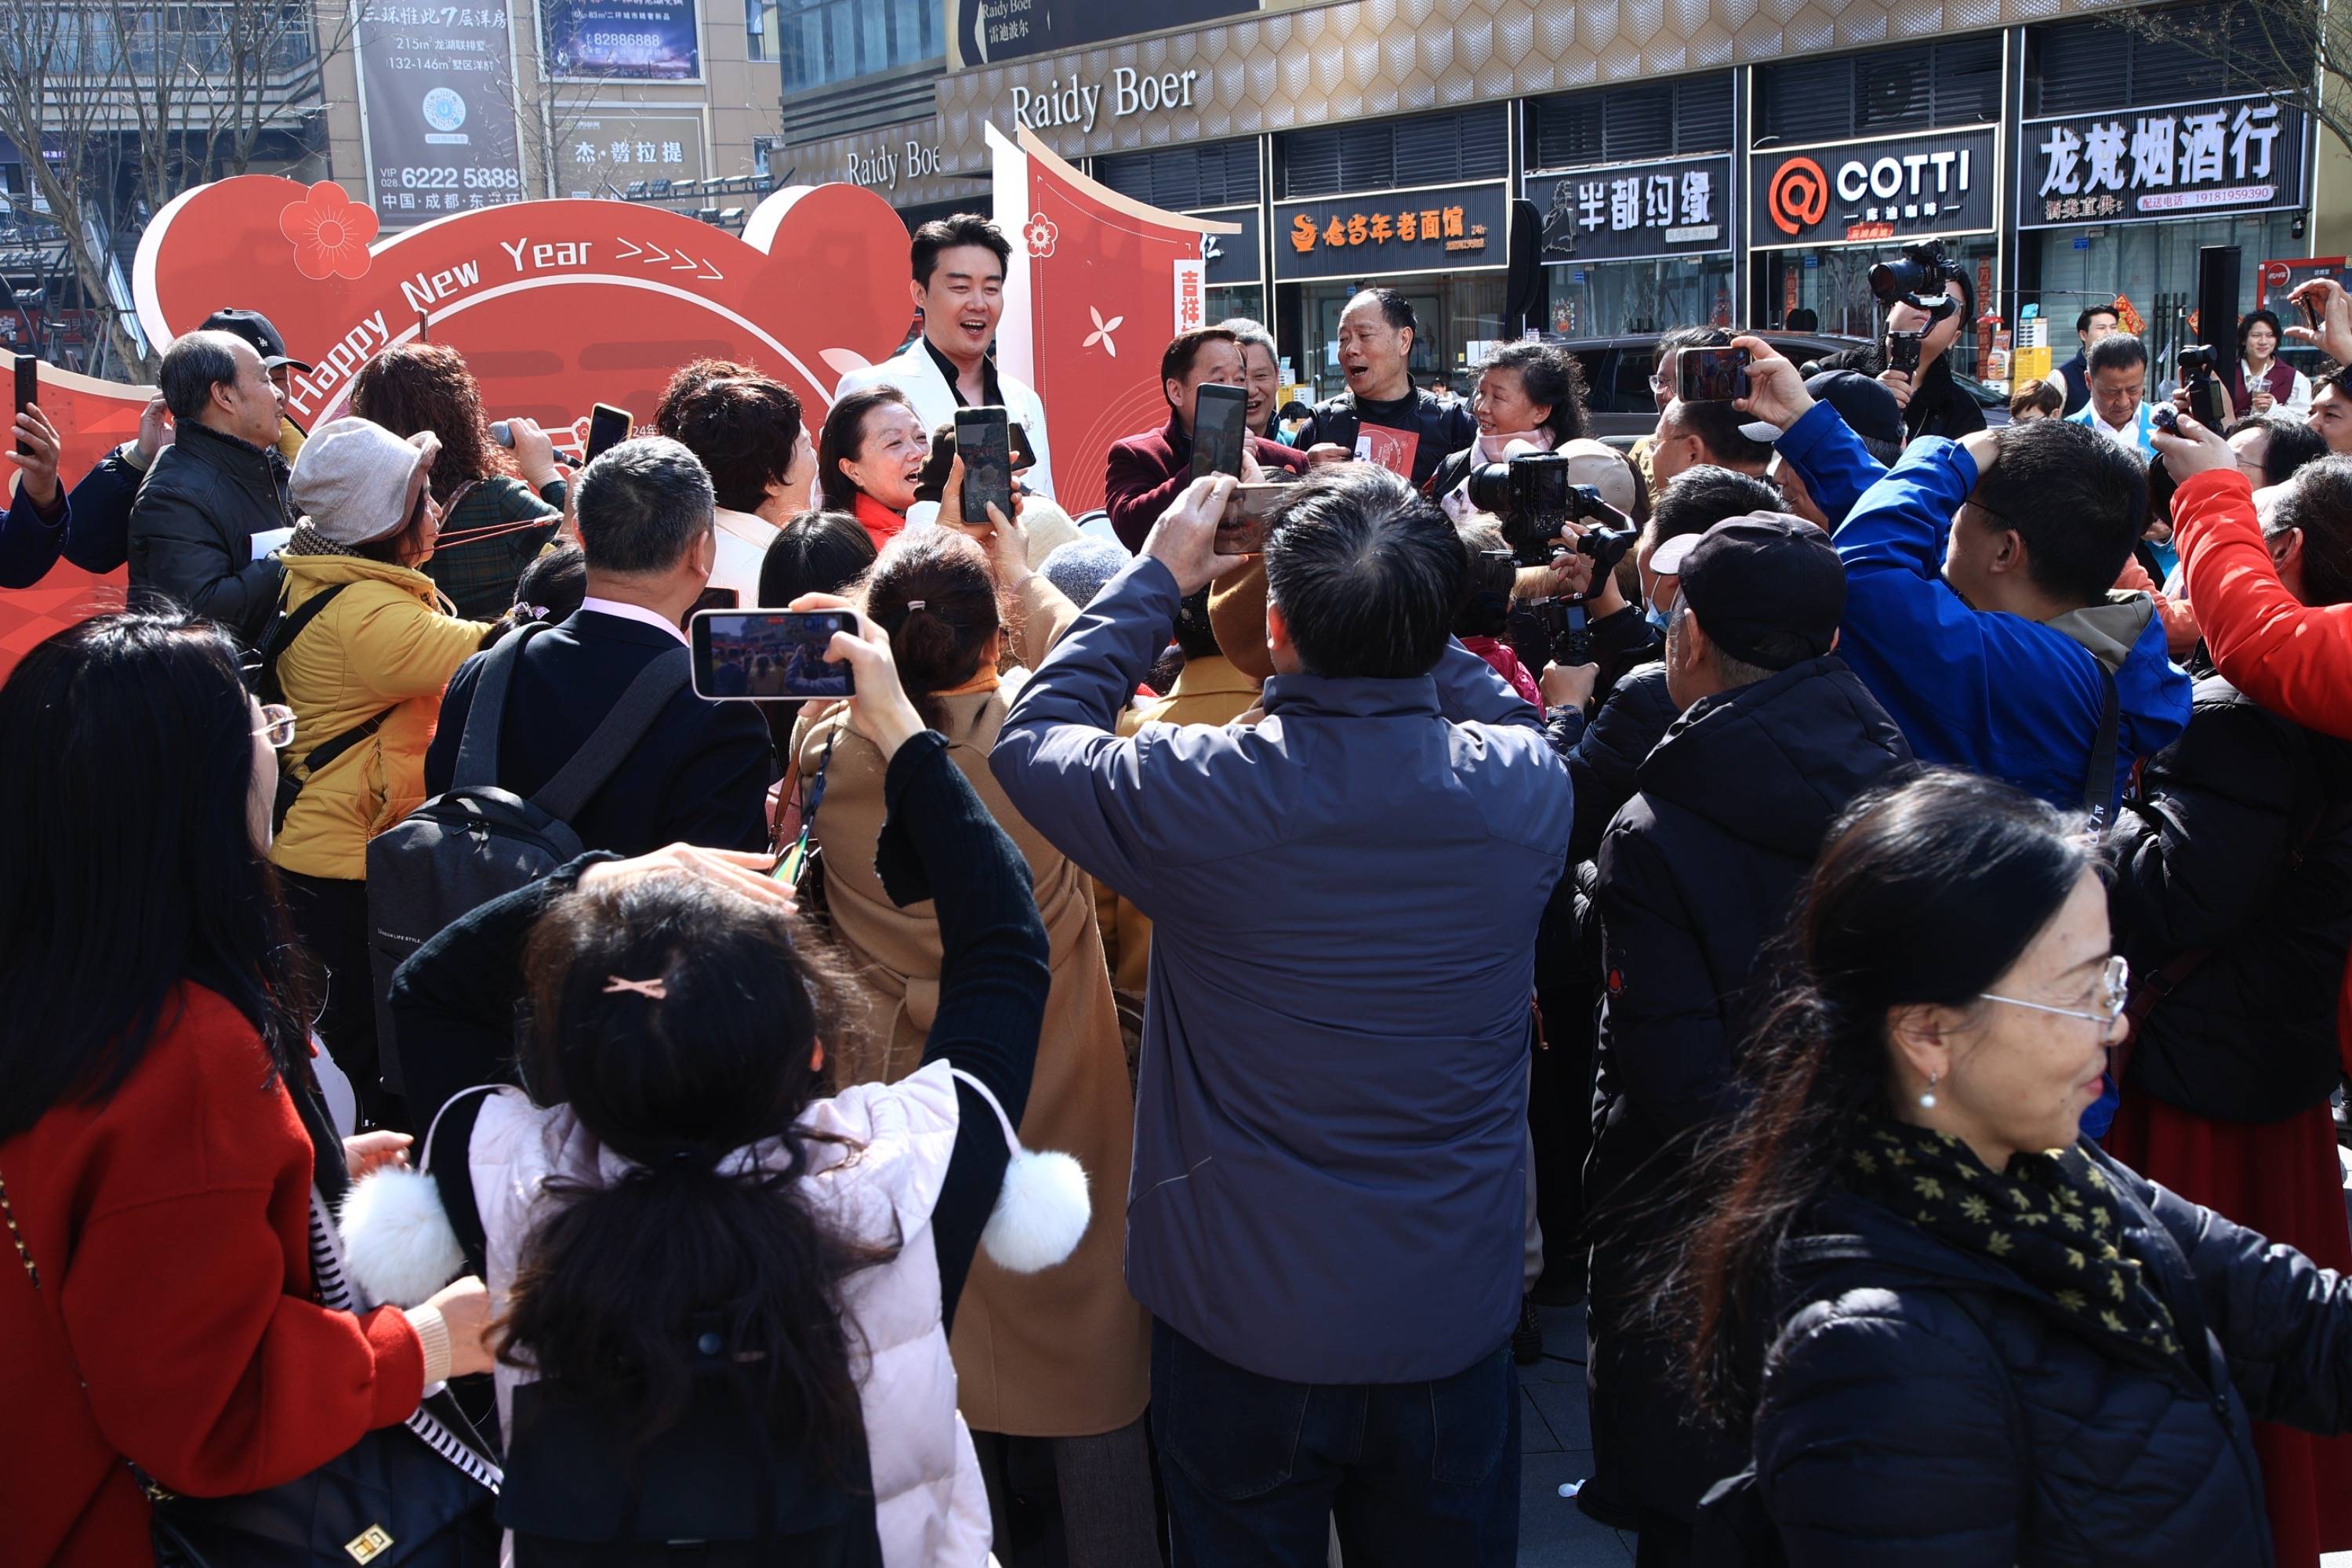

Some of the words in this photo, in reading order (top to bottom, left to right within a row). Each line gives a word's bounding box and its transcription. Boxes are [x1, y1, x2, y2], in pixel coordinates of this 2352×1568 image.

[982, 0, 1009, 19] Raidy
[594, 33, 660, 47] 82886888
[989, 19, 1029, 44] 雷迪波尔
[1010, 74, 1101, 133] Raidy
[1113, 67, 1196, 116] Boer
[575, 142, 683, 163] 杰·普拉提
[847, 144, 898, 190] Raidy
[2038, 102, 2280, 197] 龙梵烟酒行
[380, 168, 397, 177] VIP
[401, 167, 459, 189] 6222
[463, 167, 519, 189] 5888
[1837, 150, 1969, 201] COTTI
[1579, 171, 1710, 232] 半都约缘
[2195, 187, 2270, 204] 19181959390
[1181, 270, 1200, 332] 吉祥
[289, 309, 390, 416] Happy
[400, 260, 480, 313] New
[499, 237, 593, 272] Year
